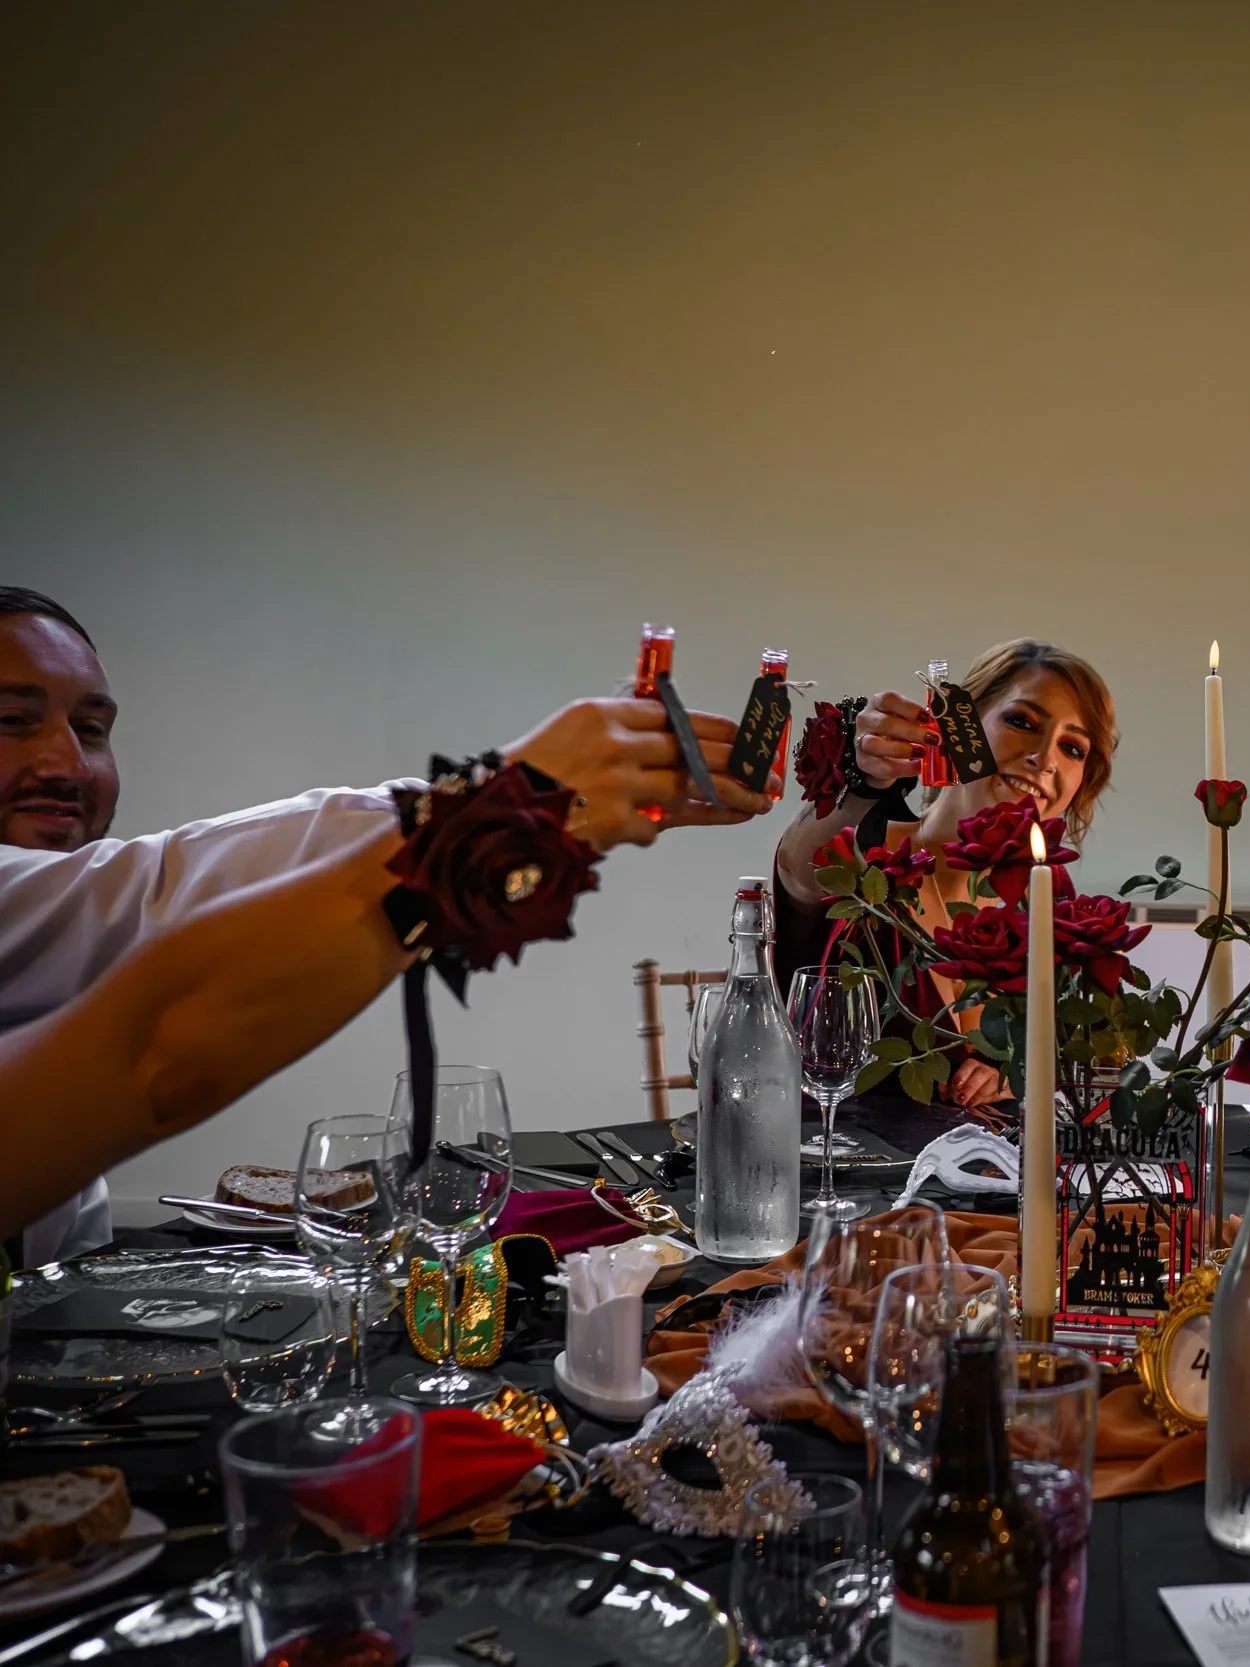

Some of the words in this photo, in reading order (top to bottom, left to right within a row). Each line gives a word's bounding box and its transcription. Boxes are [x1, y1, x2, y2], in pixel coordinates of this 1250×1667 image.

[757, 702, 786, 760] Drink
[942, 716, 960, 744] me
[955, 702, 983, 755] Drink
[1084, 1289, 1113, 1303] BRAM
[1191, 1348, 1210, 1380] 4
